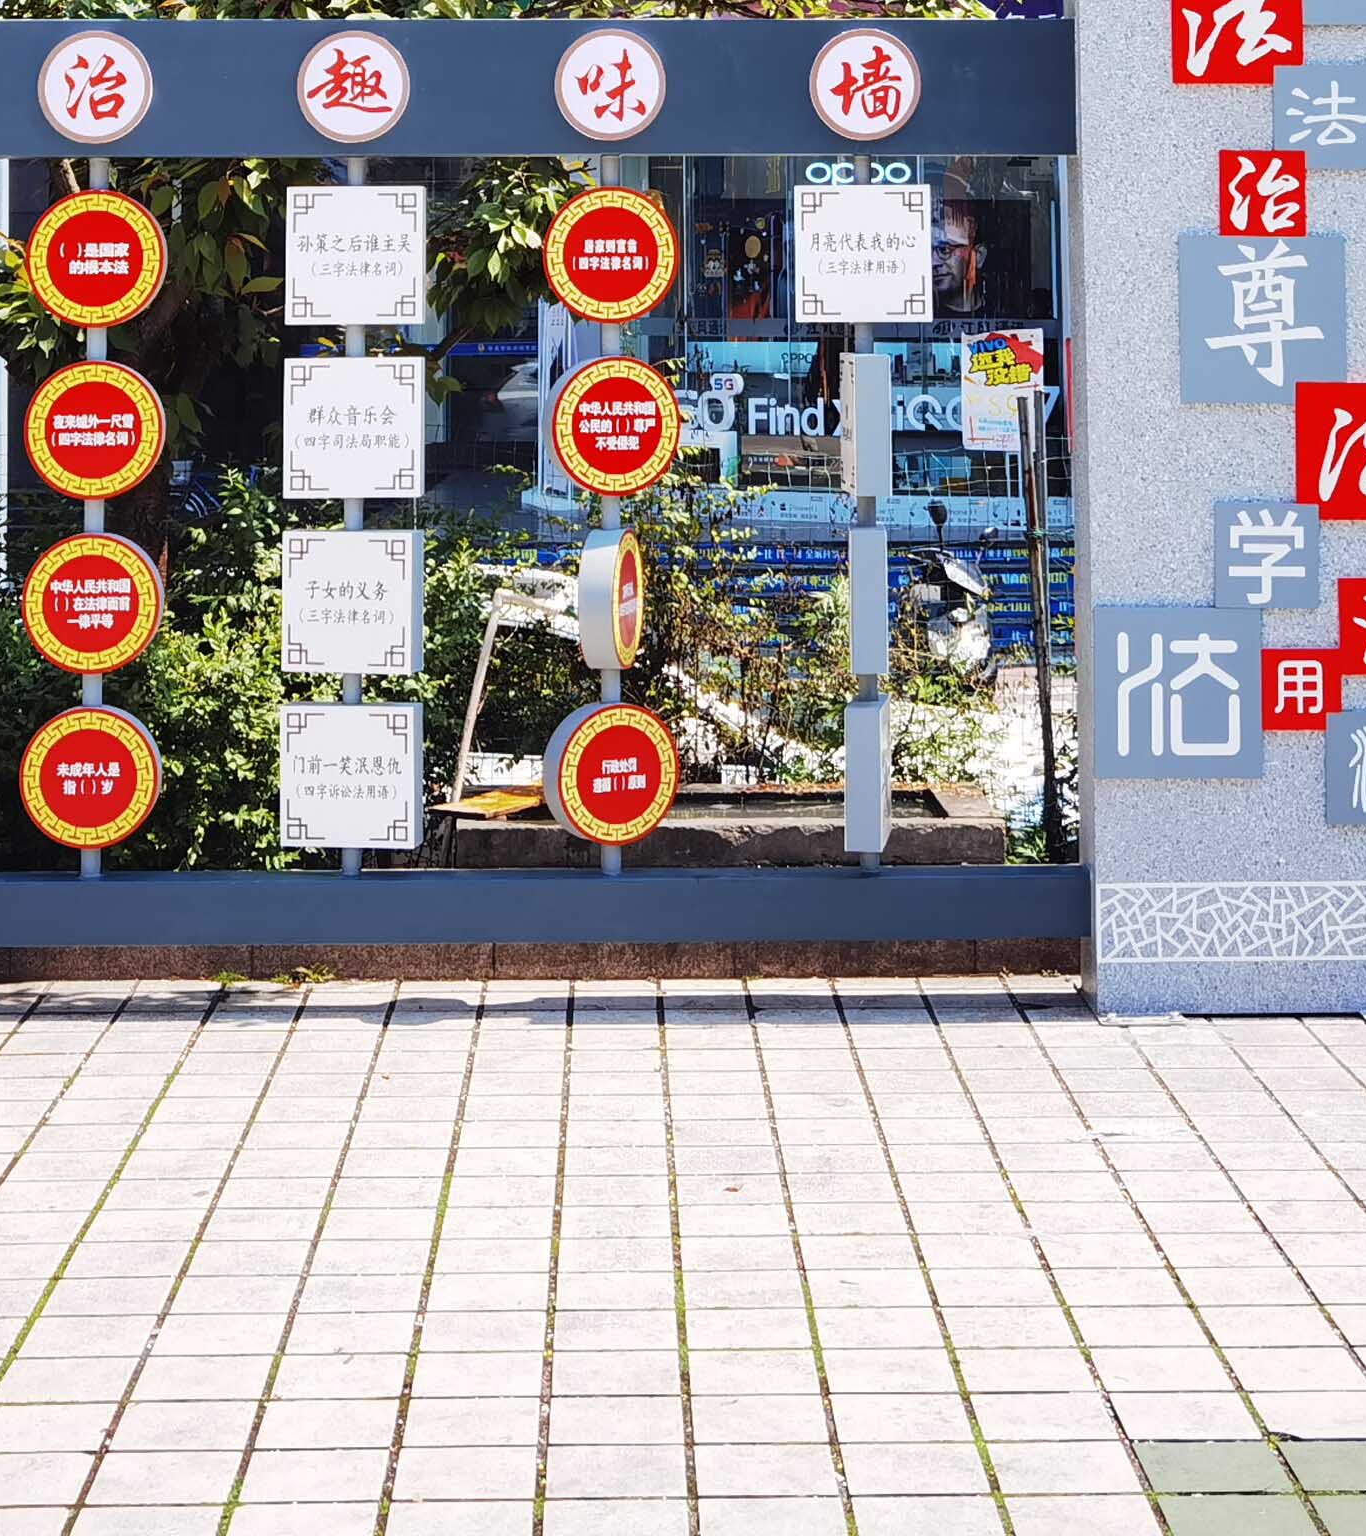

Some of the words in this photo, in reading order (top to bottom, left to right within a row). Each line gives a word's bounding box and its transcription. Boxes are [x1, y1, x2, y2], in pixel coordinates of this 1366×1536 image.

[297, 233, 412, 254] 孙策之后谁主吴
[809, 232, 916, 253] 月亮代表我的心
[69, 260, 129, 275] 的根本法
[311, 262, 404, 278] （三字法律名词）
[1204, 239, 1325, 387] 尊
[967, 339, 1007, 353] vivo
[714, 378, 734, 391] 5G
[307, 406, 396, 427] 群众音乐会
[579, 401, 656, 416] 中华人民共和国
[748, 397, 825, 436] Find
[595, 436, 640, 451] 不受侵犯
[1228, 508, 1306, 605] 学
[50, 579, 131, 594] 中华人民共和国
[304, 580, 390, 602] 子女的义务
[67, 614, 114, 630] 一律平等
[297, 608, 396, 626] （三字法律名词）
[57, 762, 121, 778] 未成年人是
[292, 755, 403, 777] 门前一笑泯恩仇
